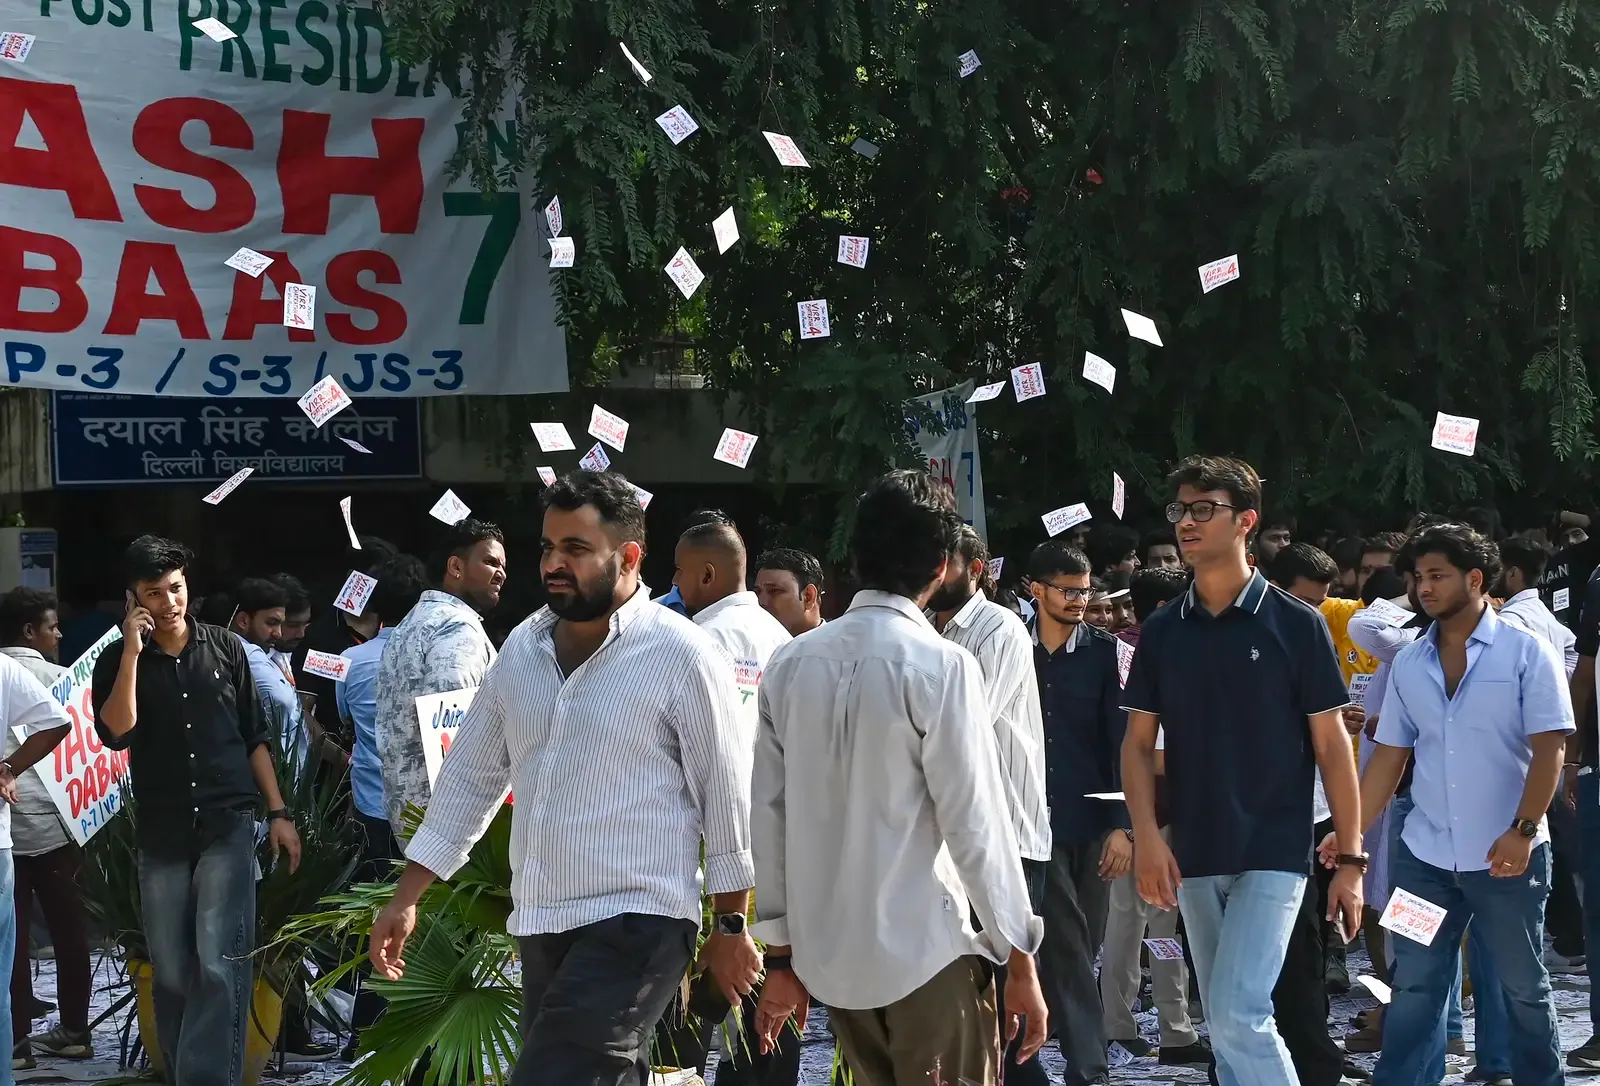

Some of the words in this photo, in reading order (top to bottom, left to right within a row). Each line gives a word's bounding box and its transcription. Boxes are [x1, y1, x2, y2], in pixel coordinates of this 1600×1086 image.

[0, 51, 17, 59] 4
[179, 0, 462, 97] PRESID
[663, 109, 679, 122] 4
[0, 77, 425, 234] ASH
[250, 261, 267, 272] 4
[443, 192, 520, 324] 7
[671, 254, 686, 272] 4
[1204, 266, 1222, 279] VIRR
[1227, 262, 1236, 278] 4
[0, 226, 408, 345] BAAS
[680, 271, 695, 291] VIRR
[298, 288, 307, 310] VIRR
[290, 313, 305, 326] 4
[811, 303, 820, 322] VIRR
[806, 326, 822, 336] 4
[5, 341, 124, 383] P-3
[203, 354, 293, 395] S-3
[342, 350, 464, 393] JS-3
[1019, 365, 1035, 376] 4
[326, 384, 345, 404] 4
[1022, 379, 1031, 397] VIRR
[304, 393, 326, 414] VIRR
[79, 417, 185, 447] दयाल
[200, 405, 269, 446] सिंह
[595, 414, 614, 432] VIRR
[1438, 423, 1460, 436] VIRR
[616, 428, 625, 446] 4
[733, 432, 750, 442] 4
[1463, 430, 1476, 449] 4
[141, 450, 205, 475] दिल्ली
[213, 450, 346, 475] विश्वविद्यालय
[449, 498, 465, 513] 4
[1073, 507, 1087, 519] 4
[1046, 512, 1069, 525] VIRR
[354, 577, 370, 598] VIRR
[339, 597, 358, 612] 4
[1389, 613, 1406, 623] 4
[332, 662, 345, 676] 4
[432, 700, 466, 729] Join
[1387, 897, 1408, 921] 4
[1406, 915, 1436, 935] VIRR
